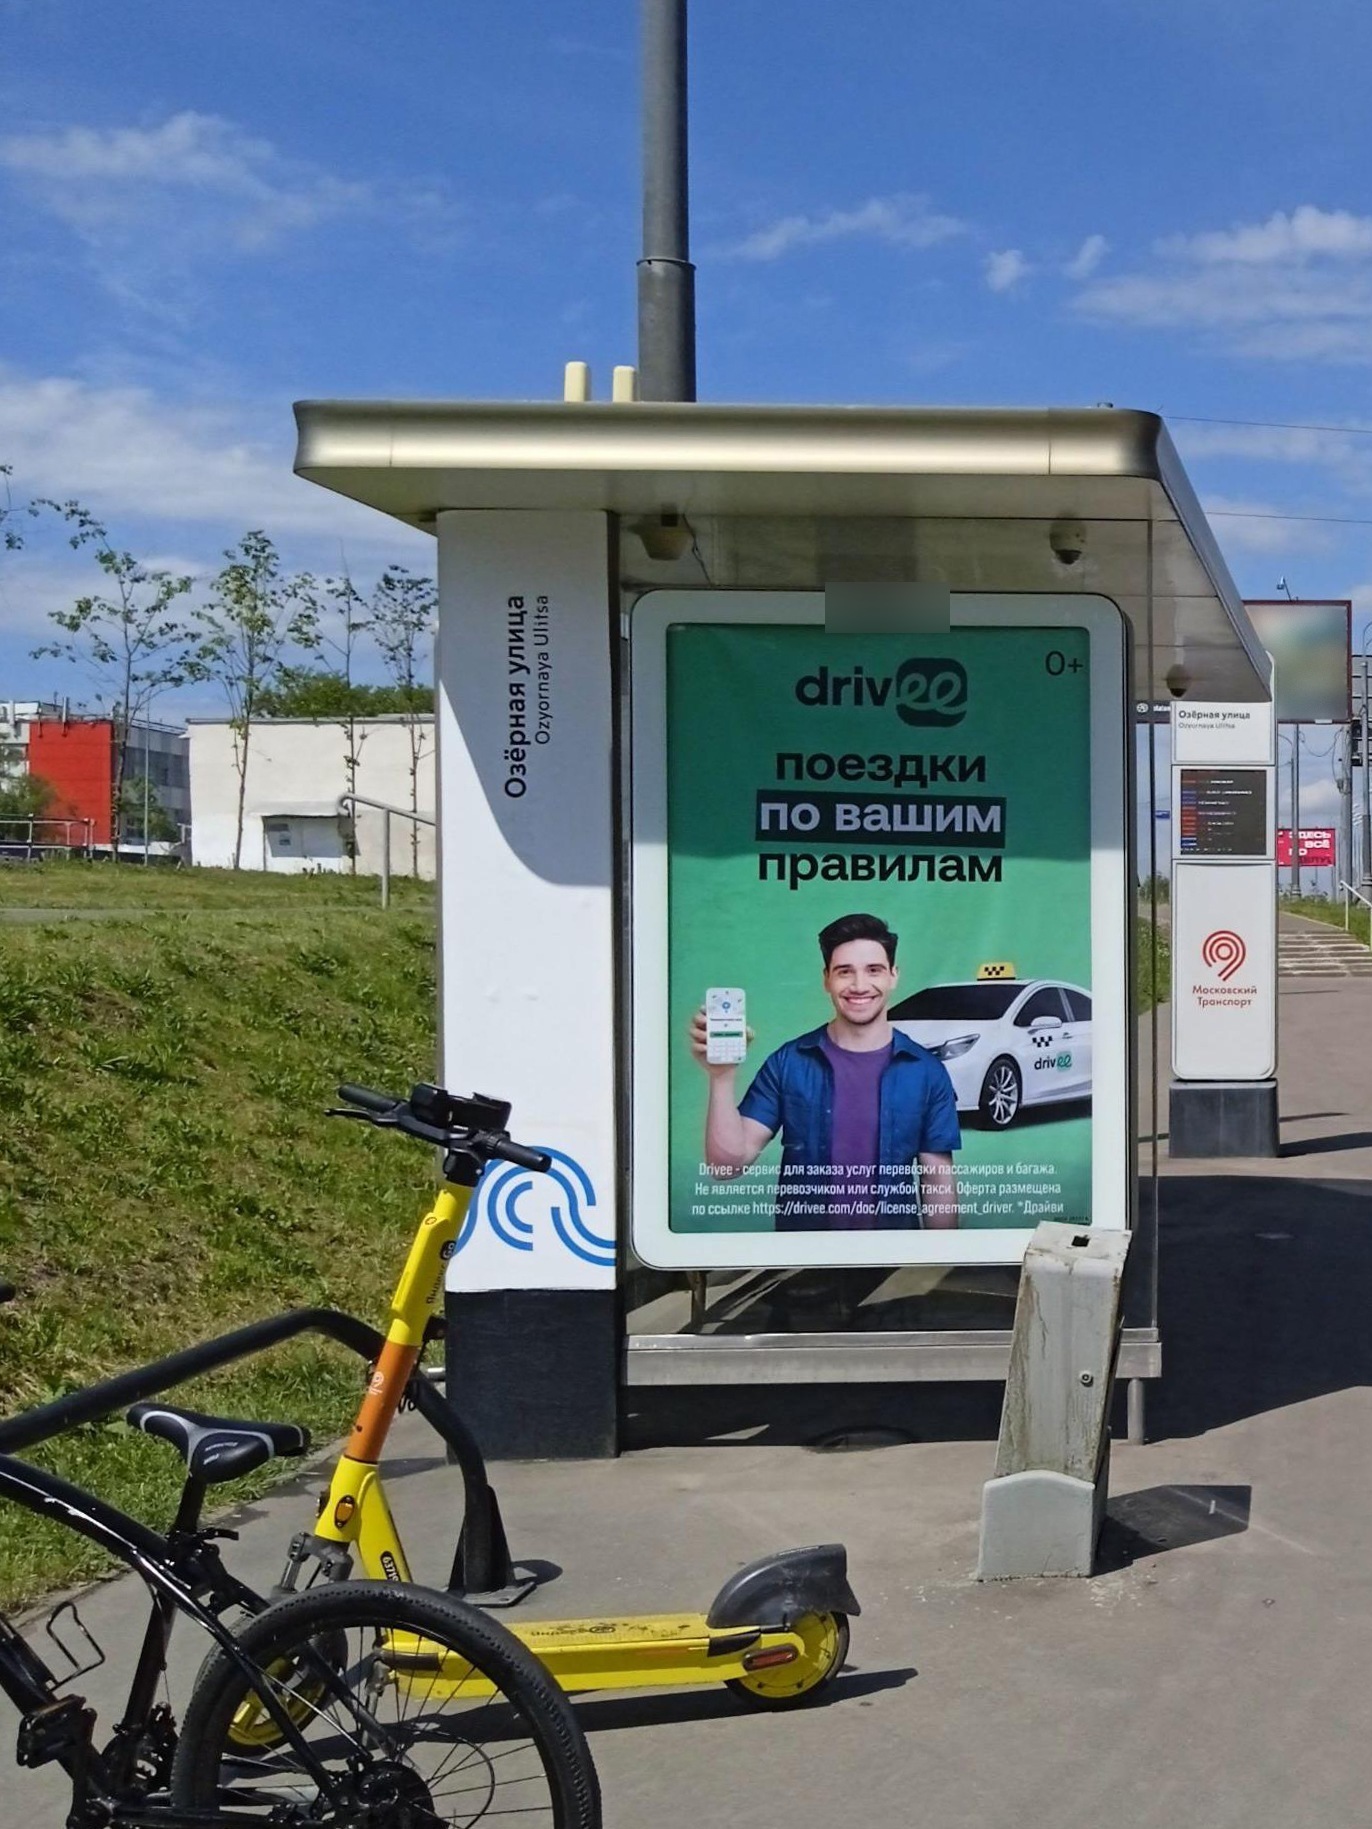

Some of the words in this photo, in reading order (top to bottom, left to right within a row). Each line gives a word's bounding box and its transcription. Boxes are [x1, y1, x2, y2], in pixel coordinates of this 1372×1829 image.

[534, 595, 549, 646] Ulitsa
[508, 596, 530, 675] улица
[1045, 651, 1083, 676] 0+
[535, 652, 553, 744] Ozyornaya
[795, 659, 967, 724] drivee
[1178, 710, 1220, 720] Озёрная
[1222, 711, 1251, 721] улица
[504, 682, 531, 798] Озёрная
[776, 752, 986, 788] поездки
[761, 803, 820, 831] по
[835, 803, 1001, 832] вашим
[759, 853, 1002, 891] правилам
[1192, 985, 1257, 994] Московский
[1198, 996, 1252, 1008] Транспорт
[1034, 1052, 1072, 1070] drivee
[699, 1162, 733, 1176] Drivee
[742, 1164, 781, 1177] сервис
[783, 1164, 804, 1177] для
[806, 1164, 844, 1175] заказа
[846, 1164, 877, 1178] услуг
[879, 1164, 936, 1177] перевозки
[938, 1164, 1004, 1177] пассажиров
[1006, 1164, 1014, 1174] и
[1016, 1161, 1057, 1175] багажа.
[695, 1182, 709, 1196] Не
[711, 1184, 764, 1195] является
[767, 1184, 845, 1197] перевозчиком
[847, 1184, 868, 1194] или
[870, 1182, 918, 1197] службой
[921, 1184, 954, 1195] такси.
[957, 1182, 996, 1197] Оферта
[999, 1184, 1061, 1197] размещена
[692, 1205, 706, 1215] по
[708, 1204, 750, 1215] ссылке
